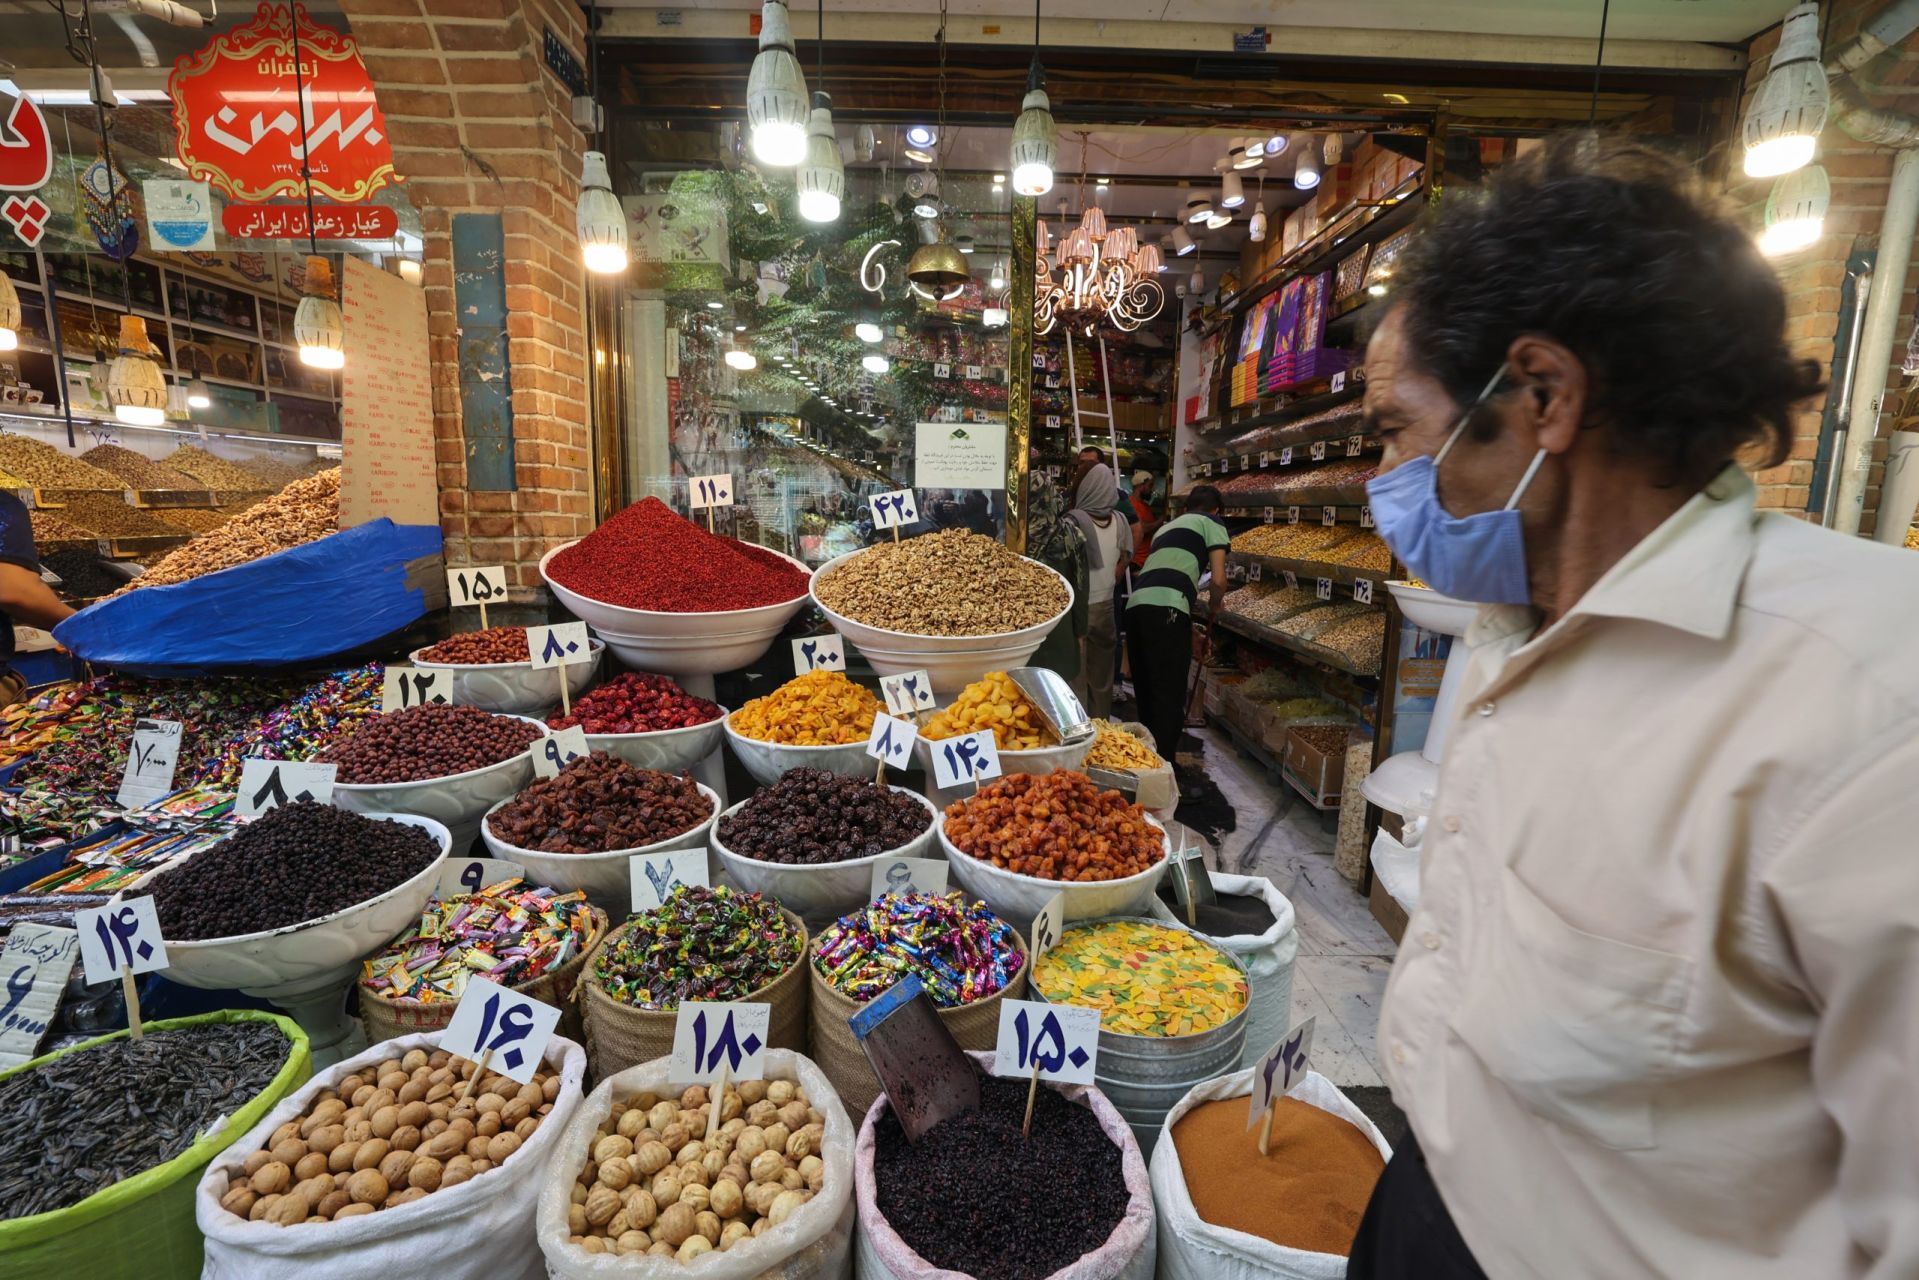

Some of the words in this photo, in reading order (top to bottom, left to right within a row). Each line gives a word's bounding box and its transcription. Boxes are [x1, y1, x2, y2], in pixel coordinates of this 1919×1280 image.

[257, 57, 318, 78] زعفران
[238, 211, 287, 237] ایرانی
[291, 210, 345, 237] زعفران
[698, 479, 728, 504] ۱۱۰
[874, 493, 914, 525] ۴۲۰
[457, 571, 506, 601] ۱۵۰
[542, 629, 579, 664] ۸۰
[801, 640, 838, 670] ۲۰۰
[398, 672, 447, 709] ۱۲۰
[545, 739, 579, 770] ۹۰
[875, 721, 903, 758] ۸۰
[943, 737, 989, 782] ۱۴۰
[252, 765, 315, 811] ۸۰
[644, 858, 683, 904] ۷۰
[95, 906, 154, 972] ۱۴۰
[473, 992, 534, 1071] ۱۶۰
[692, 1009, 762, 1075] ۱۸۰
[1014, 1007, 1090, 1073] ۱۵۰
